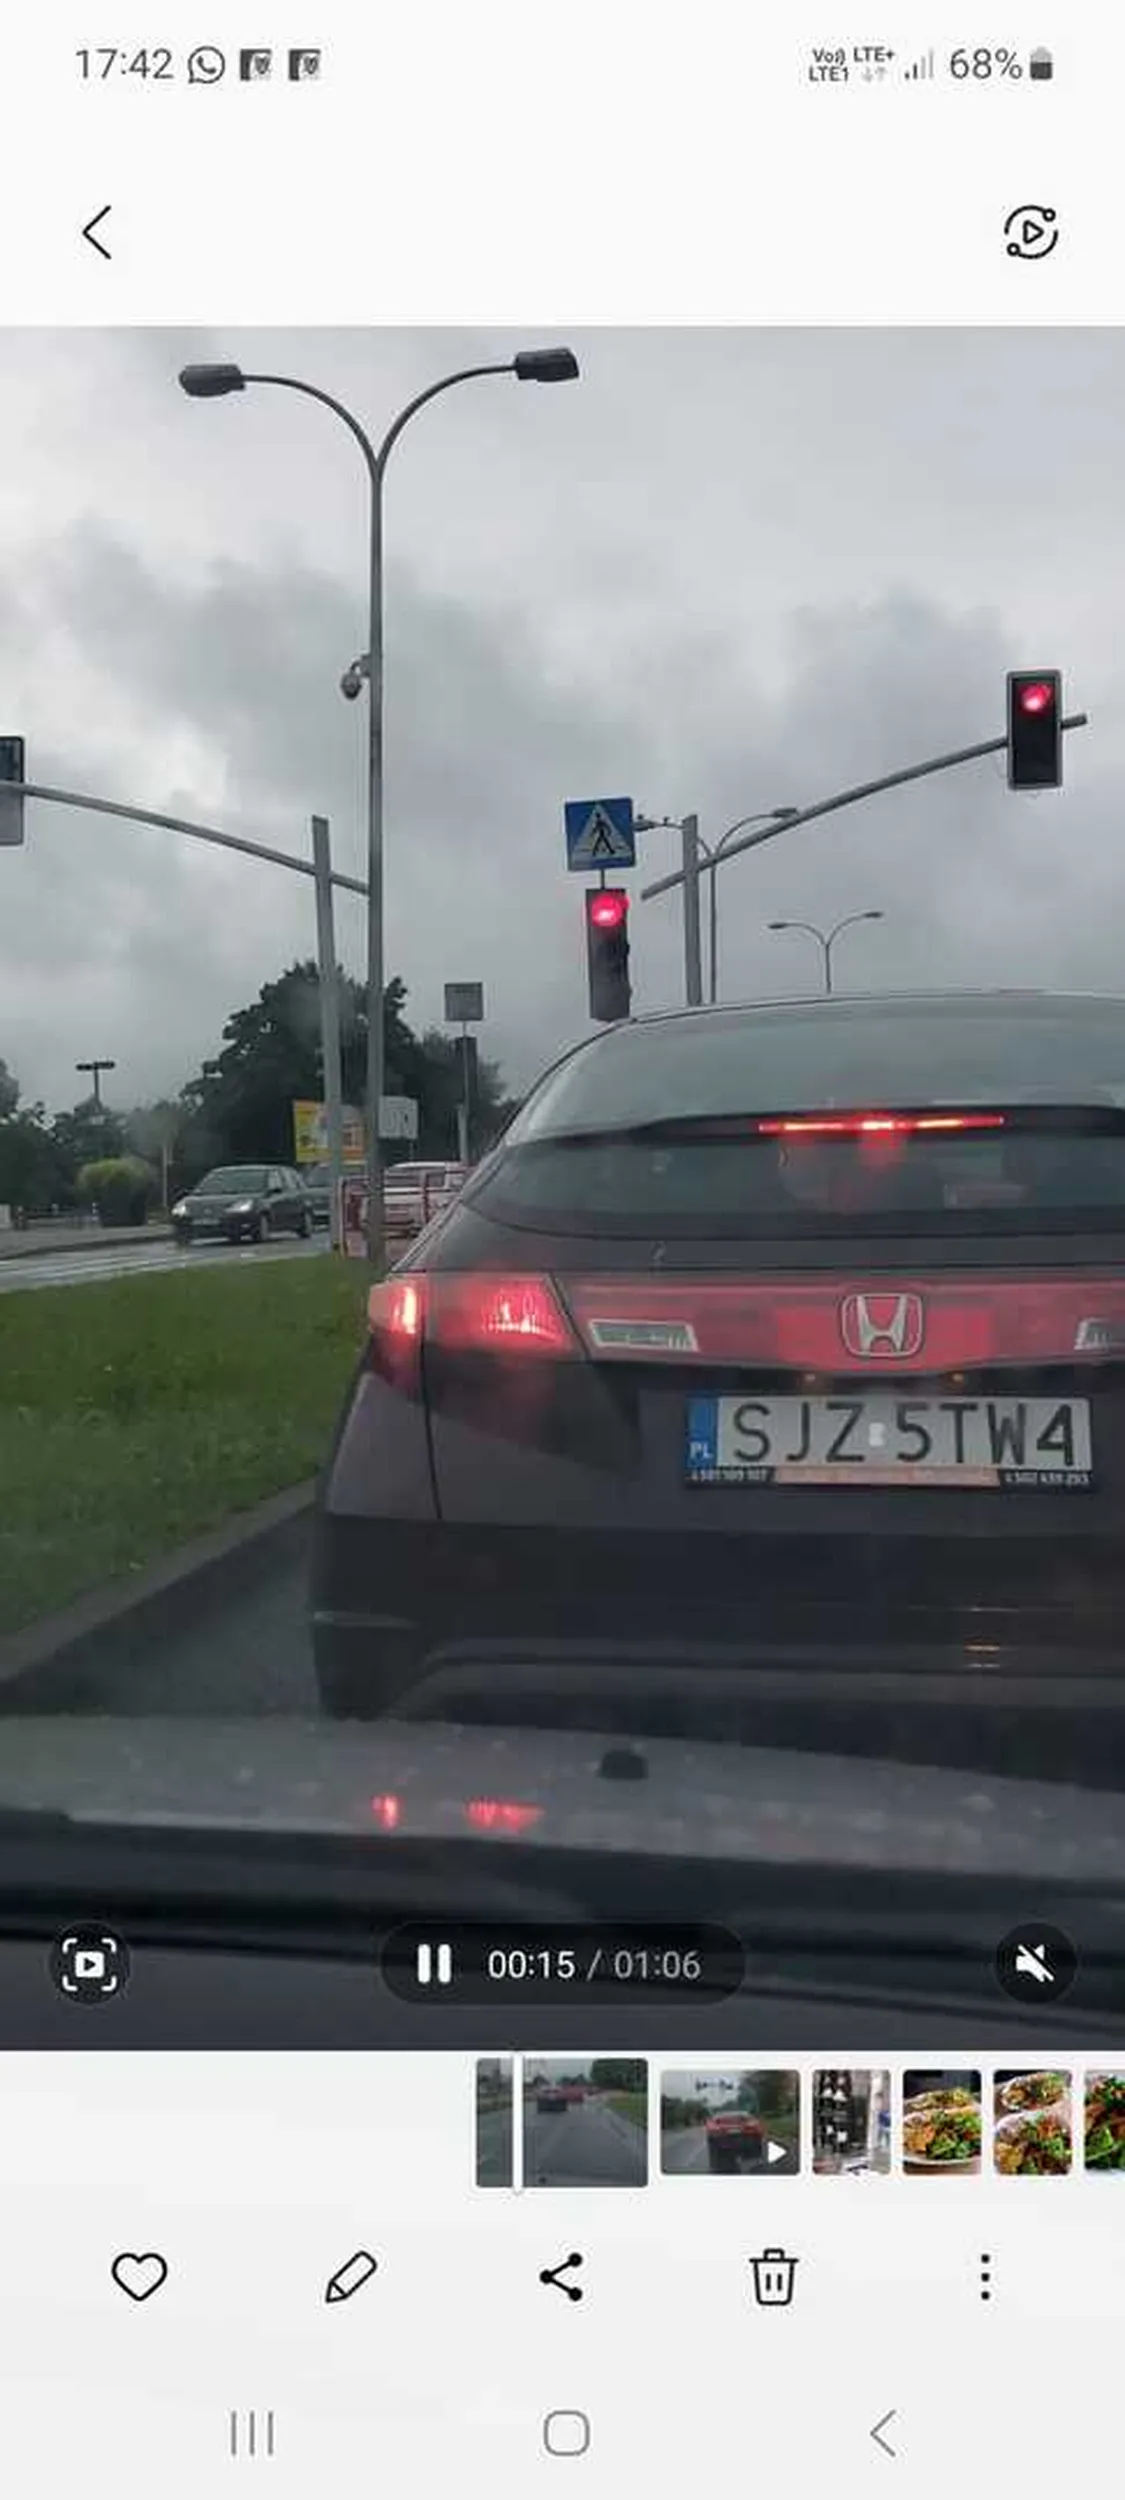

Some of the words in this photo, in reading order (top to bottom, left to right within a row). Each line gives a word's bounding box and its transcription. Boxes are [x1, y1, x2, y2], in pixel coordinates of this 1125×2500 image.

[690, 1442, 713, 1460] PL
[733, 1402, 866, 1463] SJZ
[896, 1402, 1075, 1466] 5TW4
